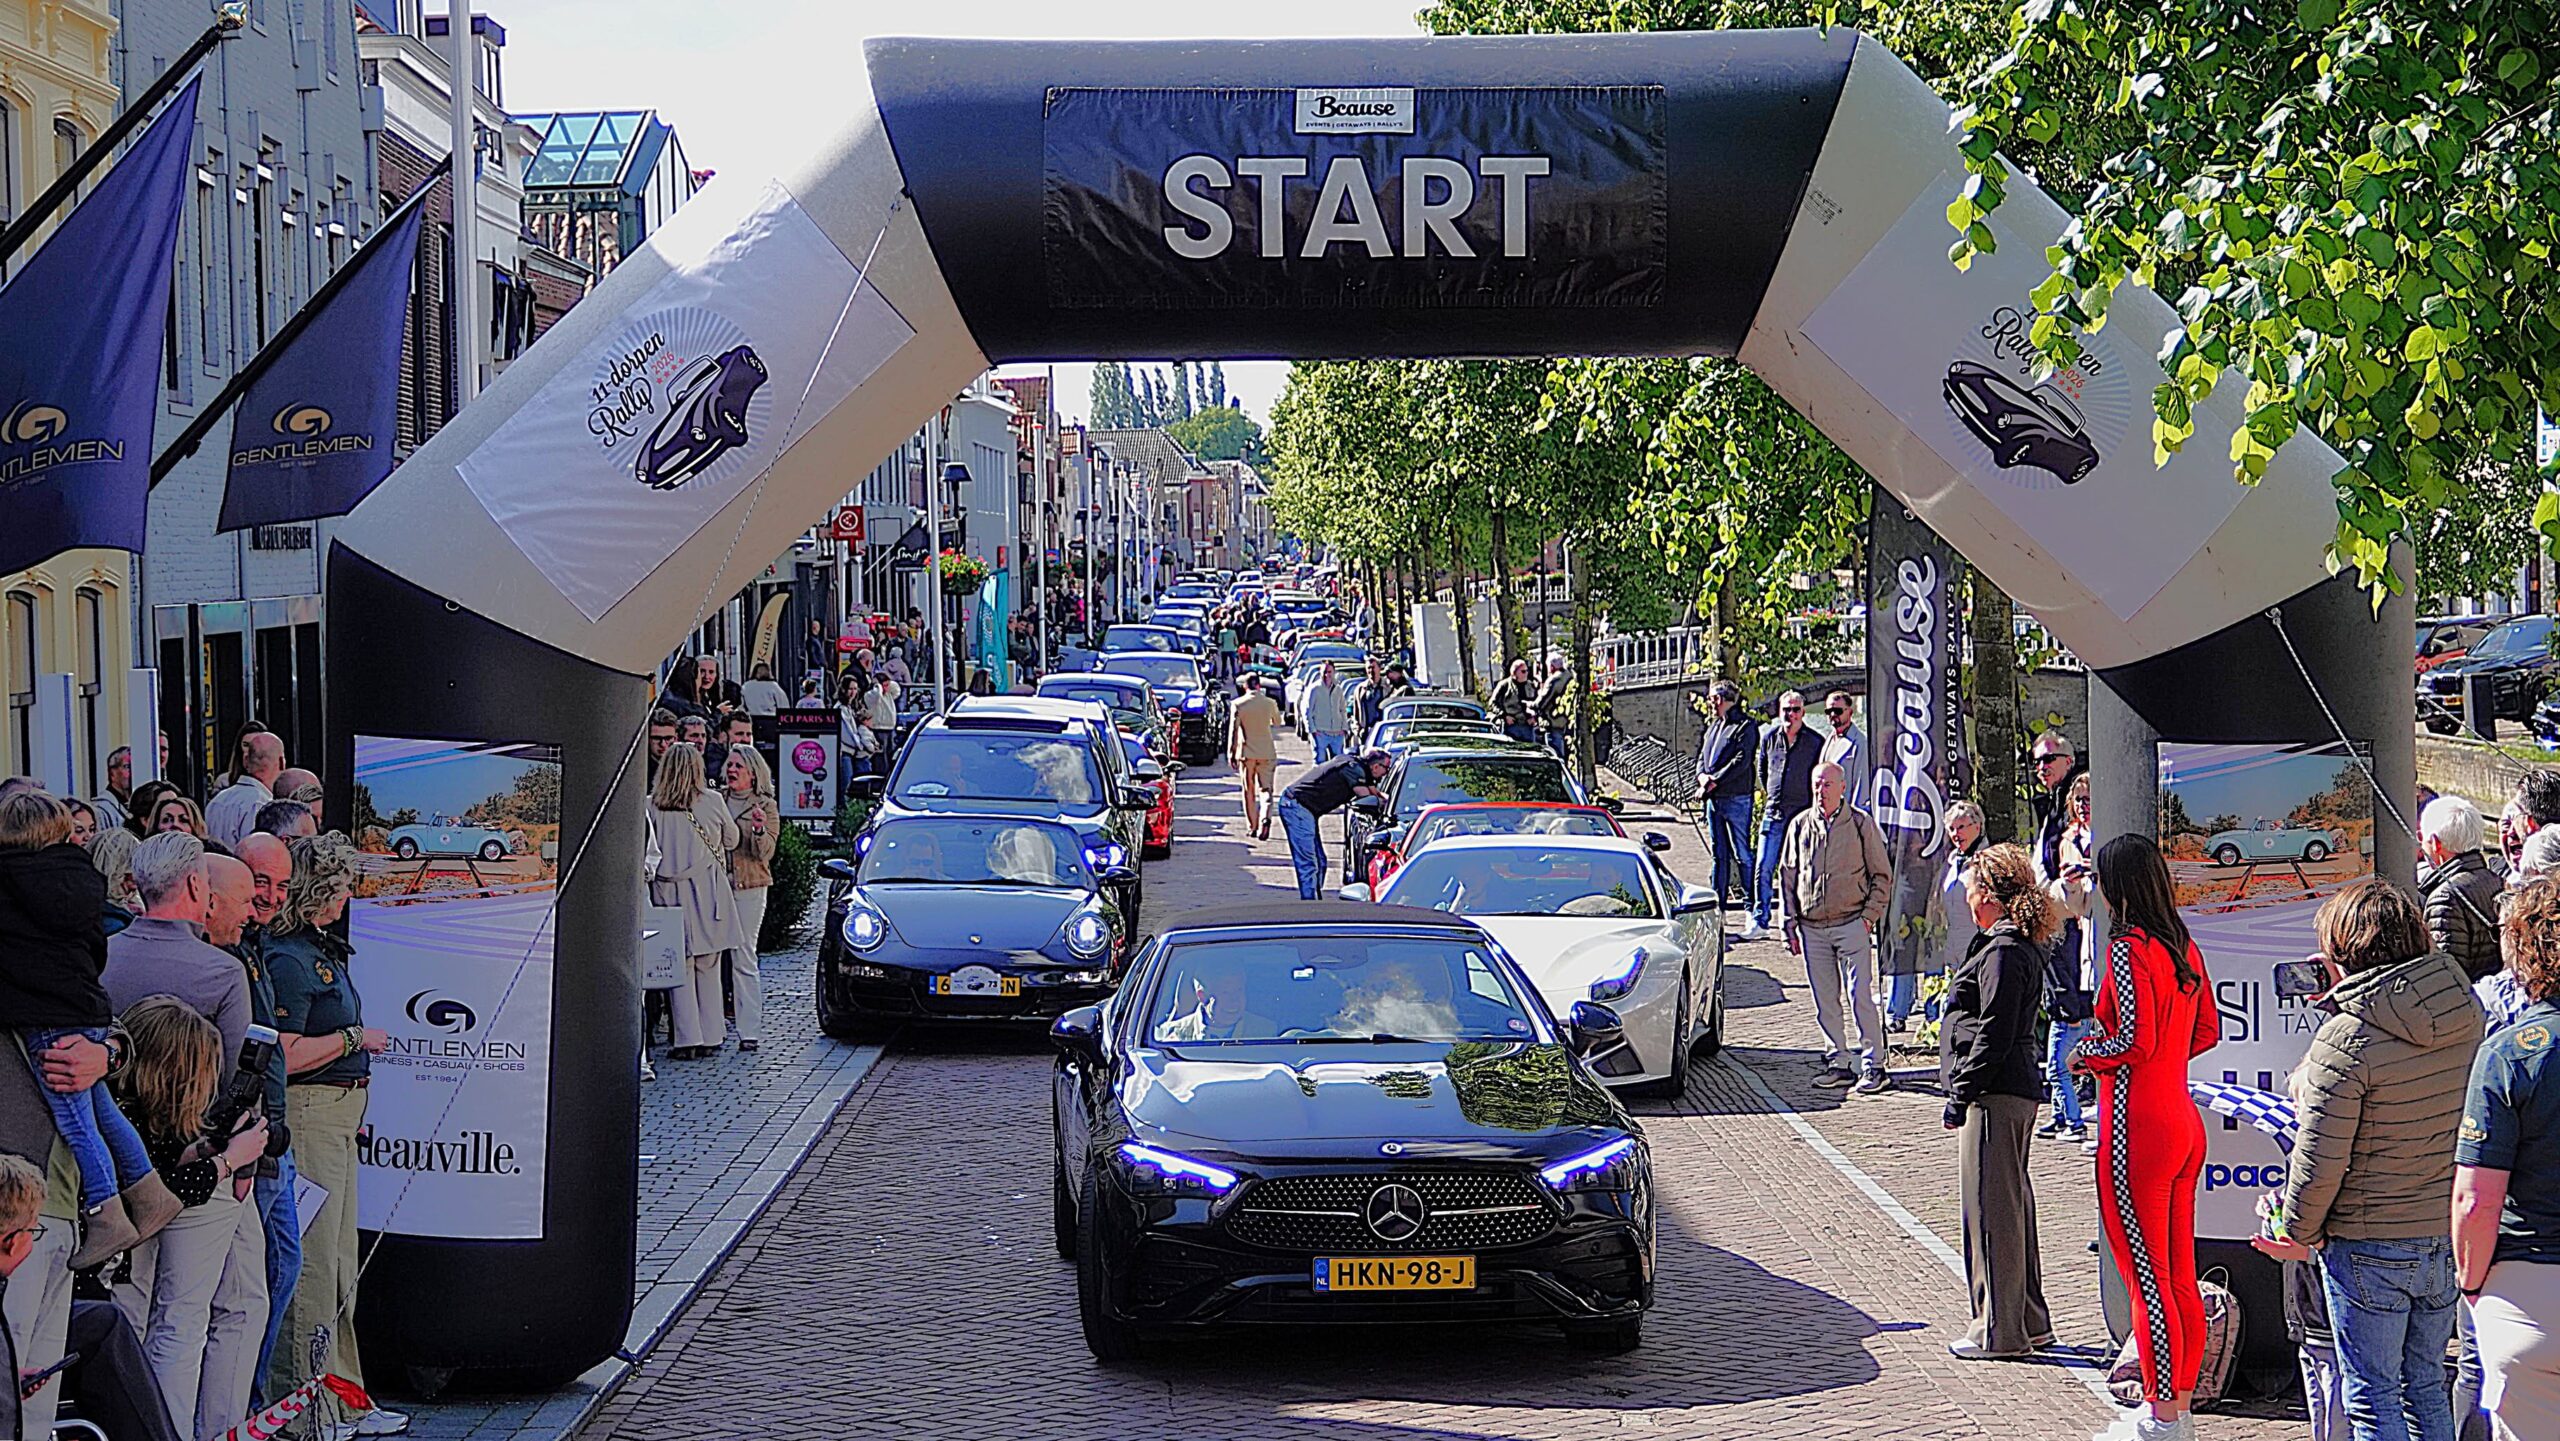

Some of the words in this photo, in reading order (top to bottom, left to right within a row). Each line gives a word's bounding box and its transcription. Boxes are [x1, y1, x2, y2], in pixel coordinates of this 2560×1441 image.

[1311, 95, 1397, 118] Bcause
[1163, 154, 1550, 260] START
[592, 332, 666, 404] 11-dorpen
[651, 351, 675, 375] 2026
[587, 376, 655, 448] Rally
[232, 434, 373, 467] GENTLEMEN
[1871, 554, 1944, 858] Bcause
[483, 1062, 525, 1071] SHOES
[357, 1123, 521, 1175] deauville.
[1337, 1259, 1465, 1287] HKN-98-J
